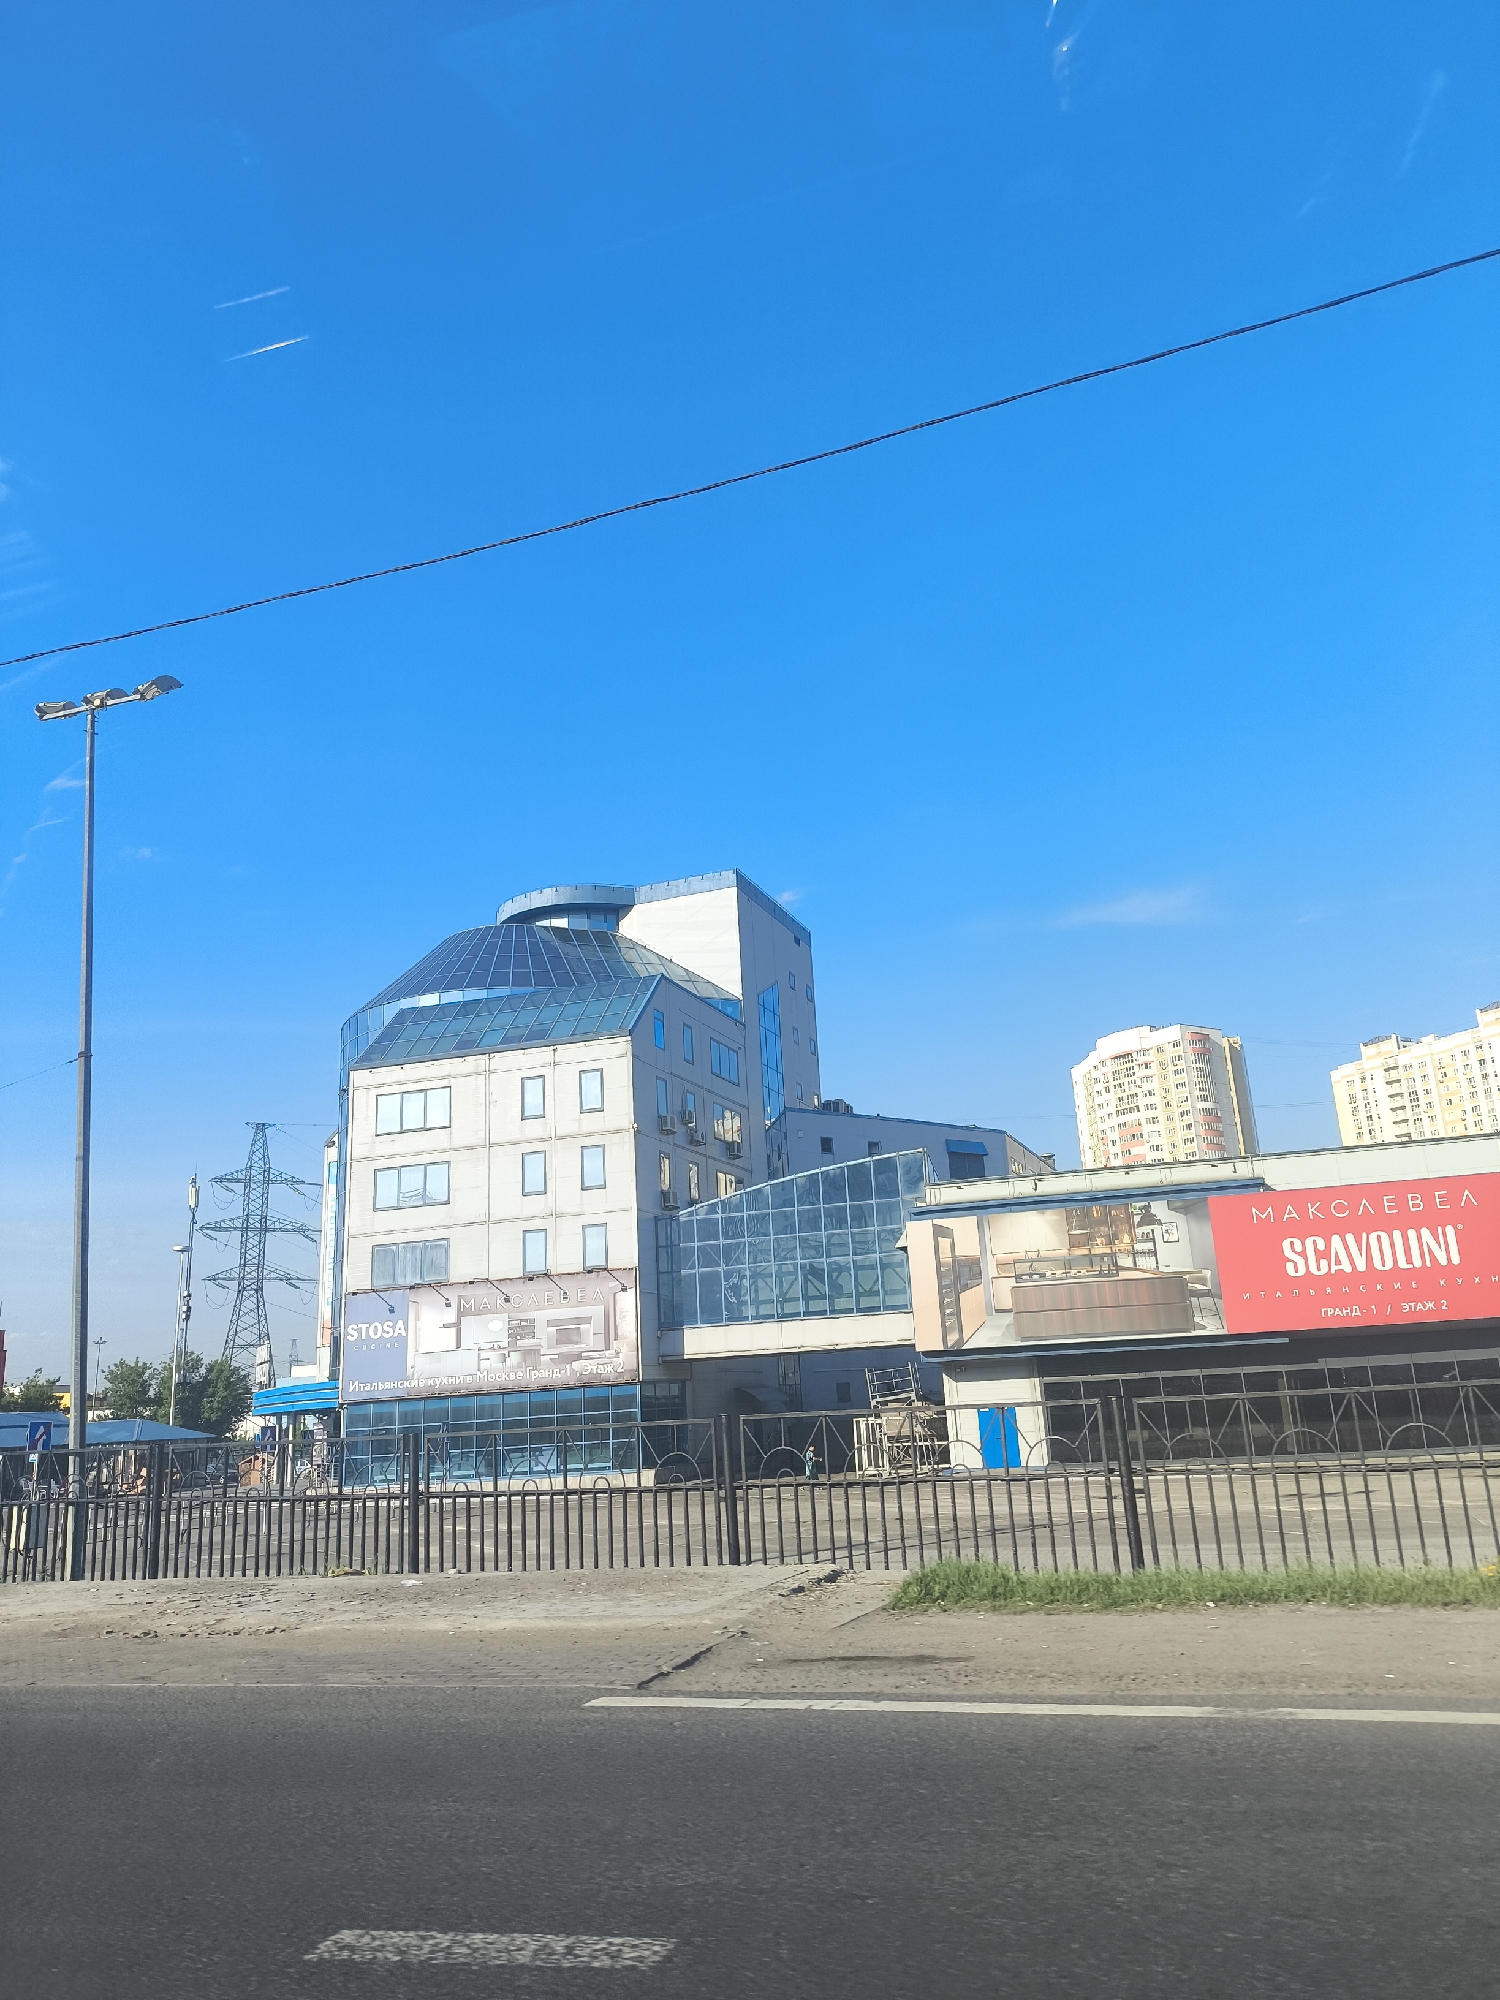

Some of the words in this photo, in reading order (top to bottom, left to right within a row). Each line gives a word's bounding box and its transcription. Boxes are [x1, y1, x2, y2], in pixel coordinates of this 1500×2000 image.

[1251, 1189, 1479, 1223] МАКСЛЕВЕЛ
[1281, 1224, 1461, 1277] SCAVOLINI
[1242, 1281, 1418, 1300] ИТАЛЬЯНСКИЕ
[1400, 1300, 1437, 1313] ЭТАЖ
[1440, 1299, 1448, 1310] 2
[346, 1319, 407, 1341] STOSA
[353, 1341, 400, 1351] CUCINE
[348, 1378, 425, 1393] Итальянские
[427, 1375, 464, 1389] кухни
[466, 1374, 473, 1384] в
[476, 1369, 523, 1383] Москве
[581, 1362, 615, 1375] Этаж
[617, 1359, 625, 1373] 2
